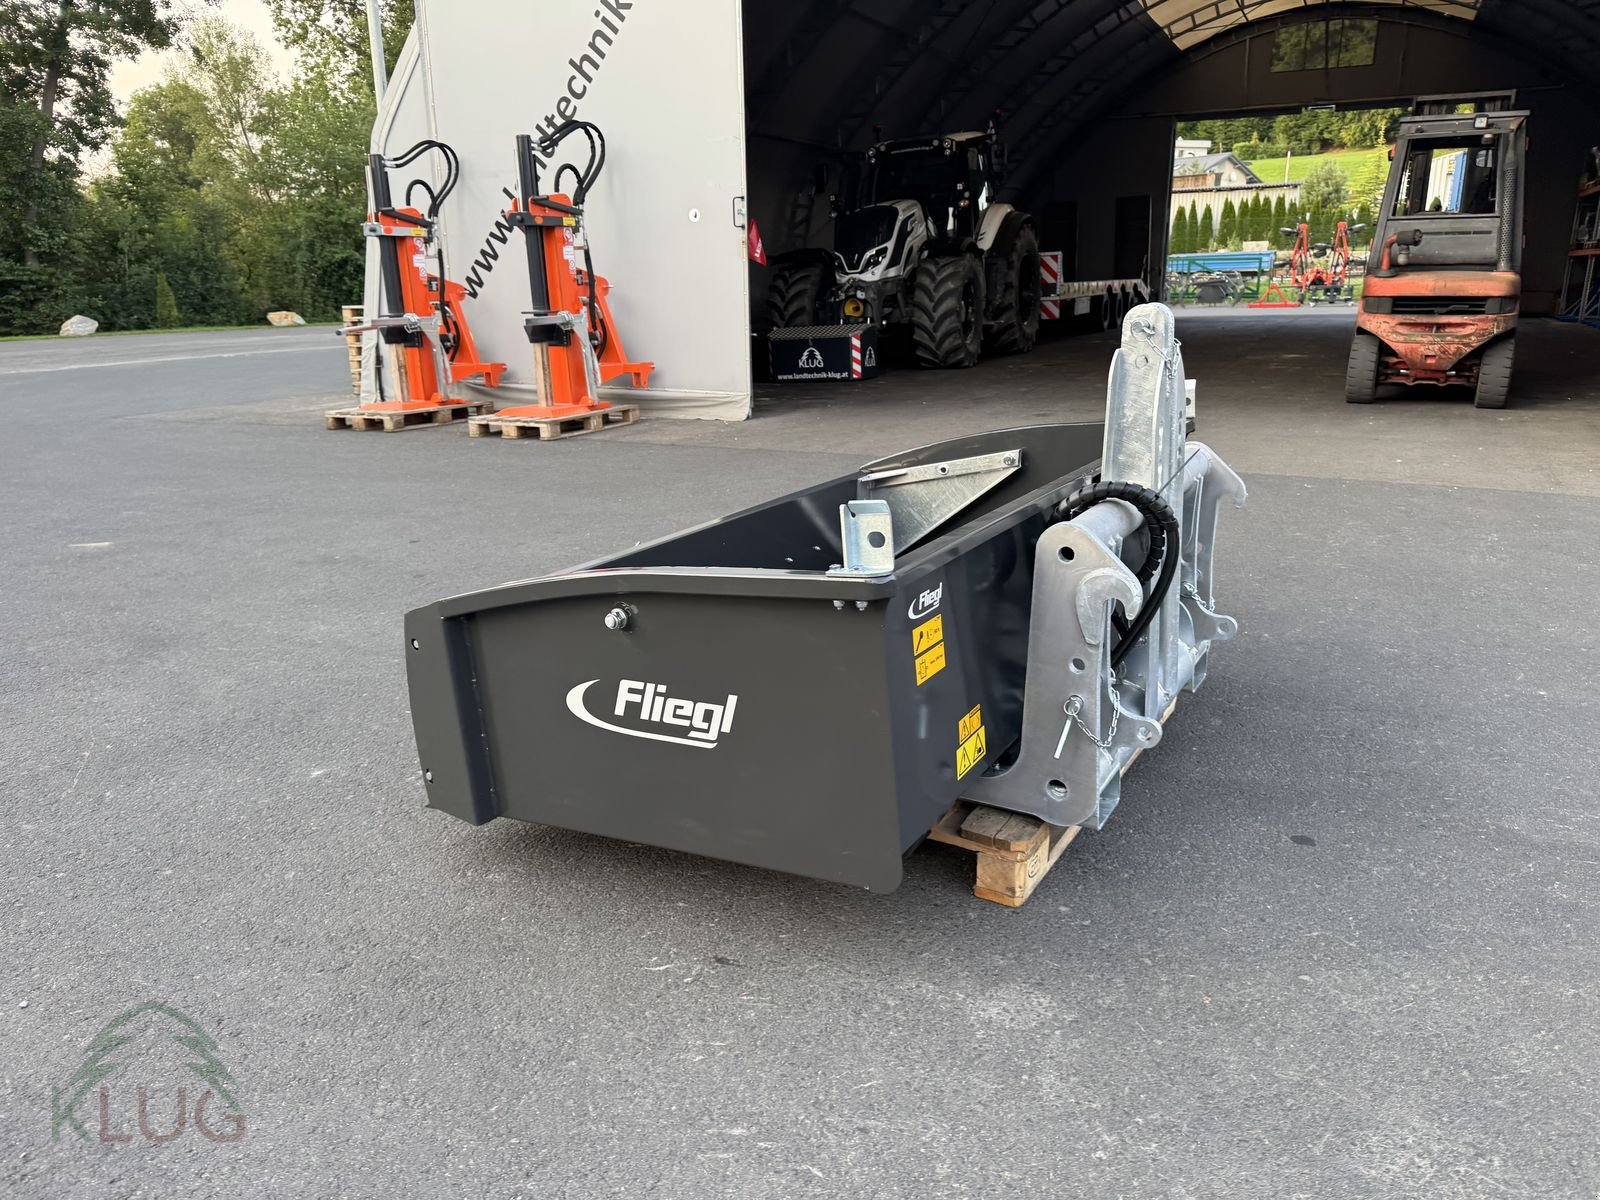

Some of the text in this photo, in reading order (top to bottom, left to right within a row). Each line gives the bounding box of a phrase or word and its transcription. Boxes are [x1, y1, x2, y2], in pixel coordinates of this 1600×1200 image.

[799, 358, 824, 368] KLUG
[777, 371, 848, 380] www.landtechnik-klug.at
[918, 582, 943, 610] Fliegl
[614, 679, 738, 741] Fliegl
